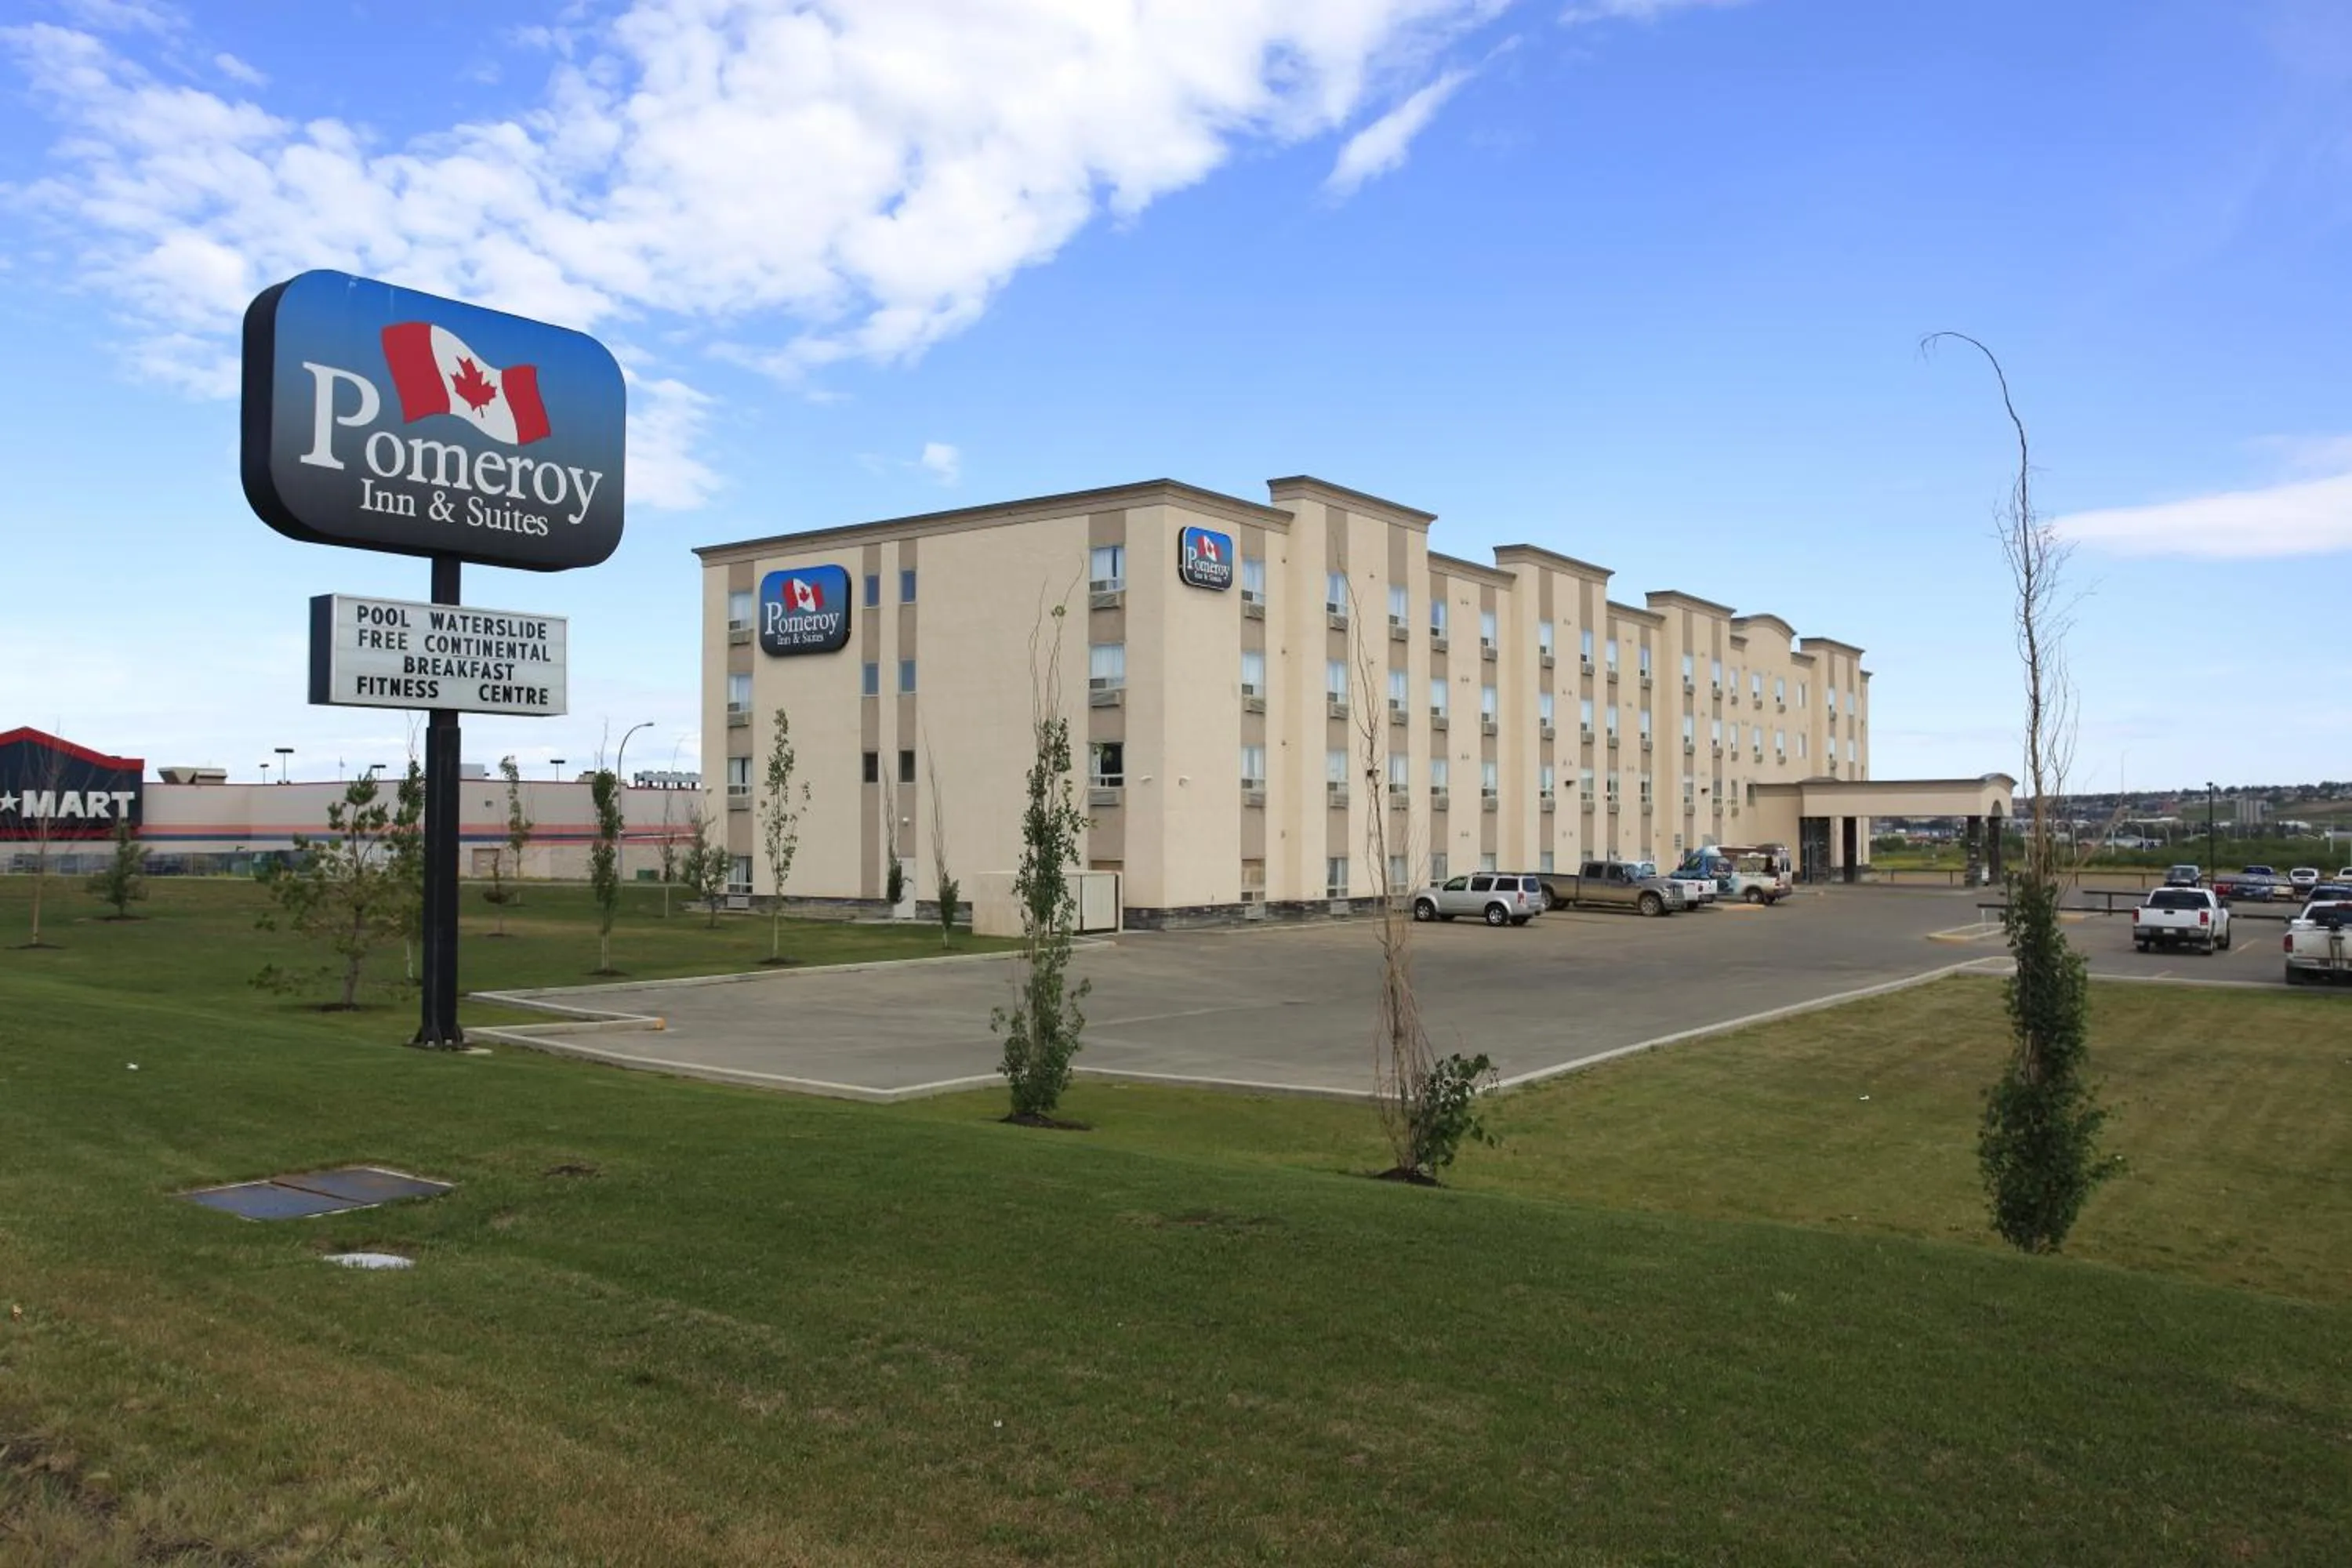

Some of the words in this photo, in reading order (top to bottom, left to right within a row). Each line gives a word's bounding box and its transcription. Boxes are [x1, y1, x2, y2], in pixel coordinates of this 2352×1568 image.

[300, 361, 602, 524] Pomeroy
[360, 478, 416, 517] Inn
[428, 490, 456, 523] &
[467, 496, 549, 536] Suites
[357, 604, 411, 628] POOL
[429, 612, 546, 641] WATERSLIDE
[764, 601, 840, 635] Pomeroy
[358, 629, 408, 651] FREE
[424, 634, 550, 662] CONTINENTAL
[404, 655, 514, 681] BREAKFAST
[357, 676, 439, 699] FITNESS
[478, 684, 548, 705] CENTRE
[22, 789, 136, 818] MART
